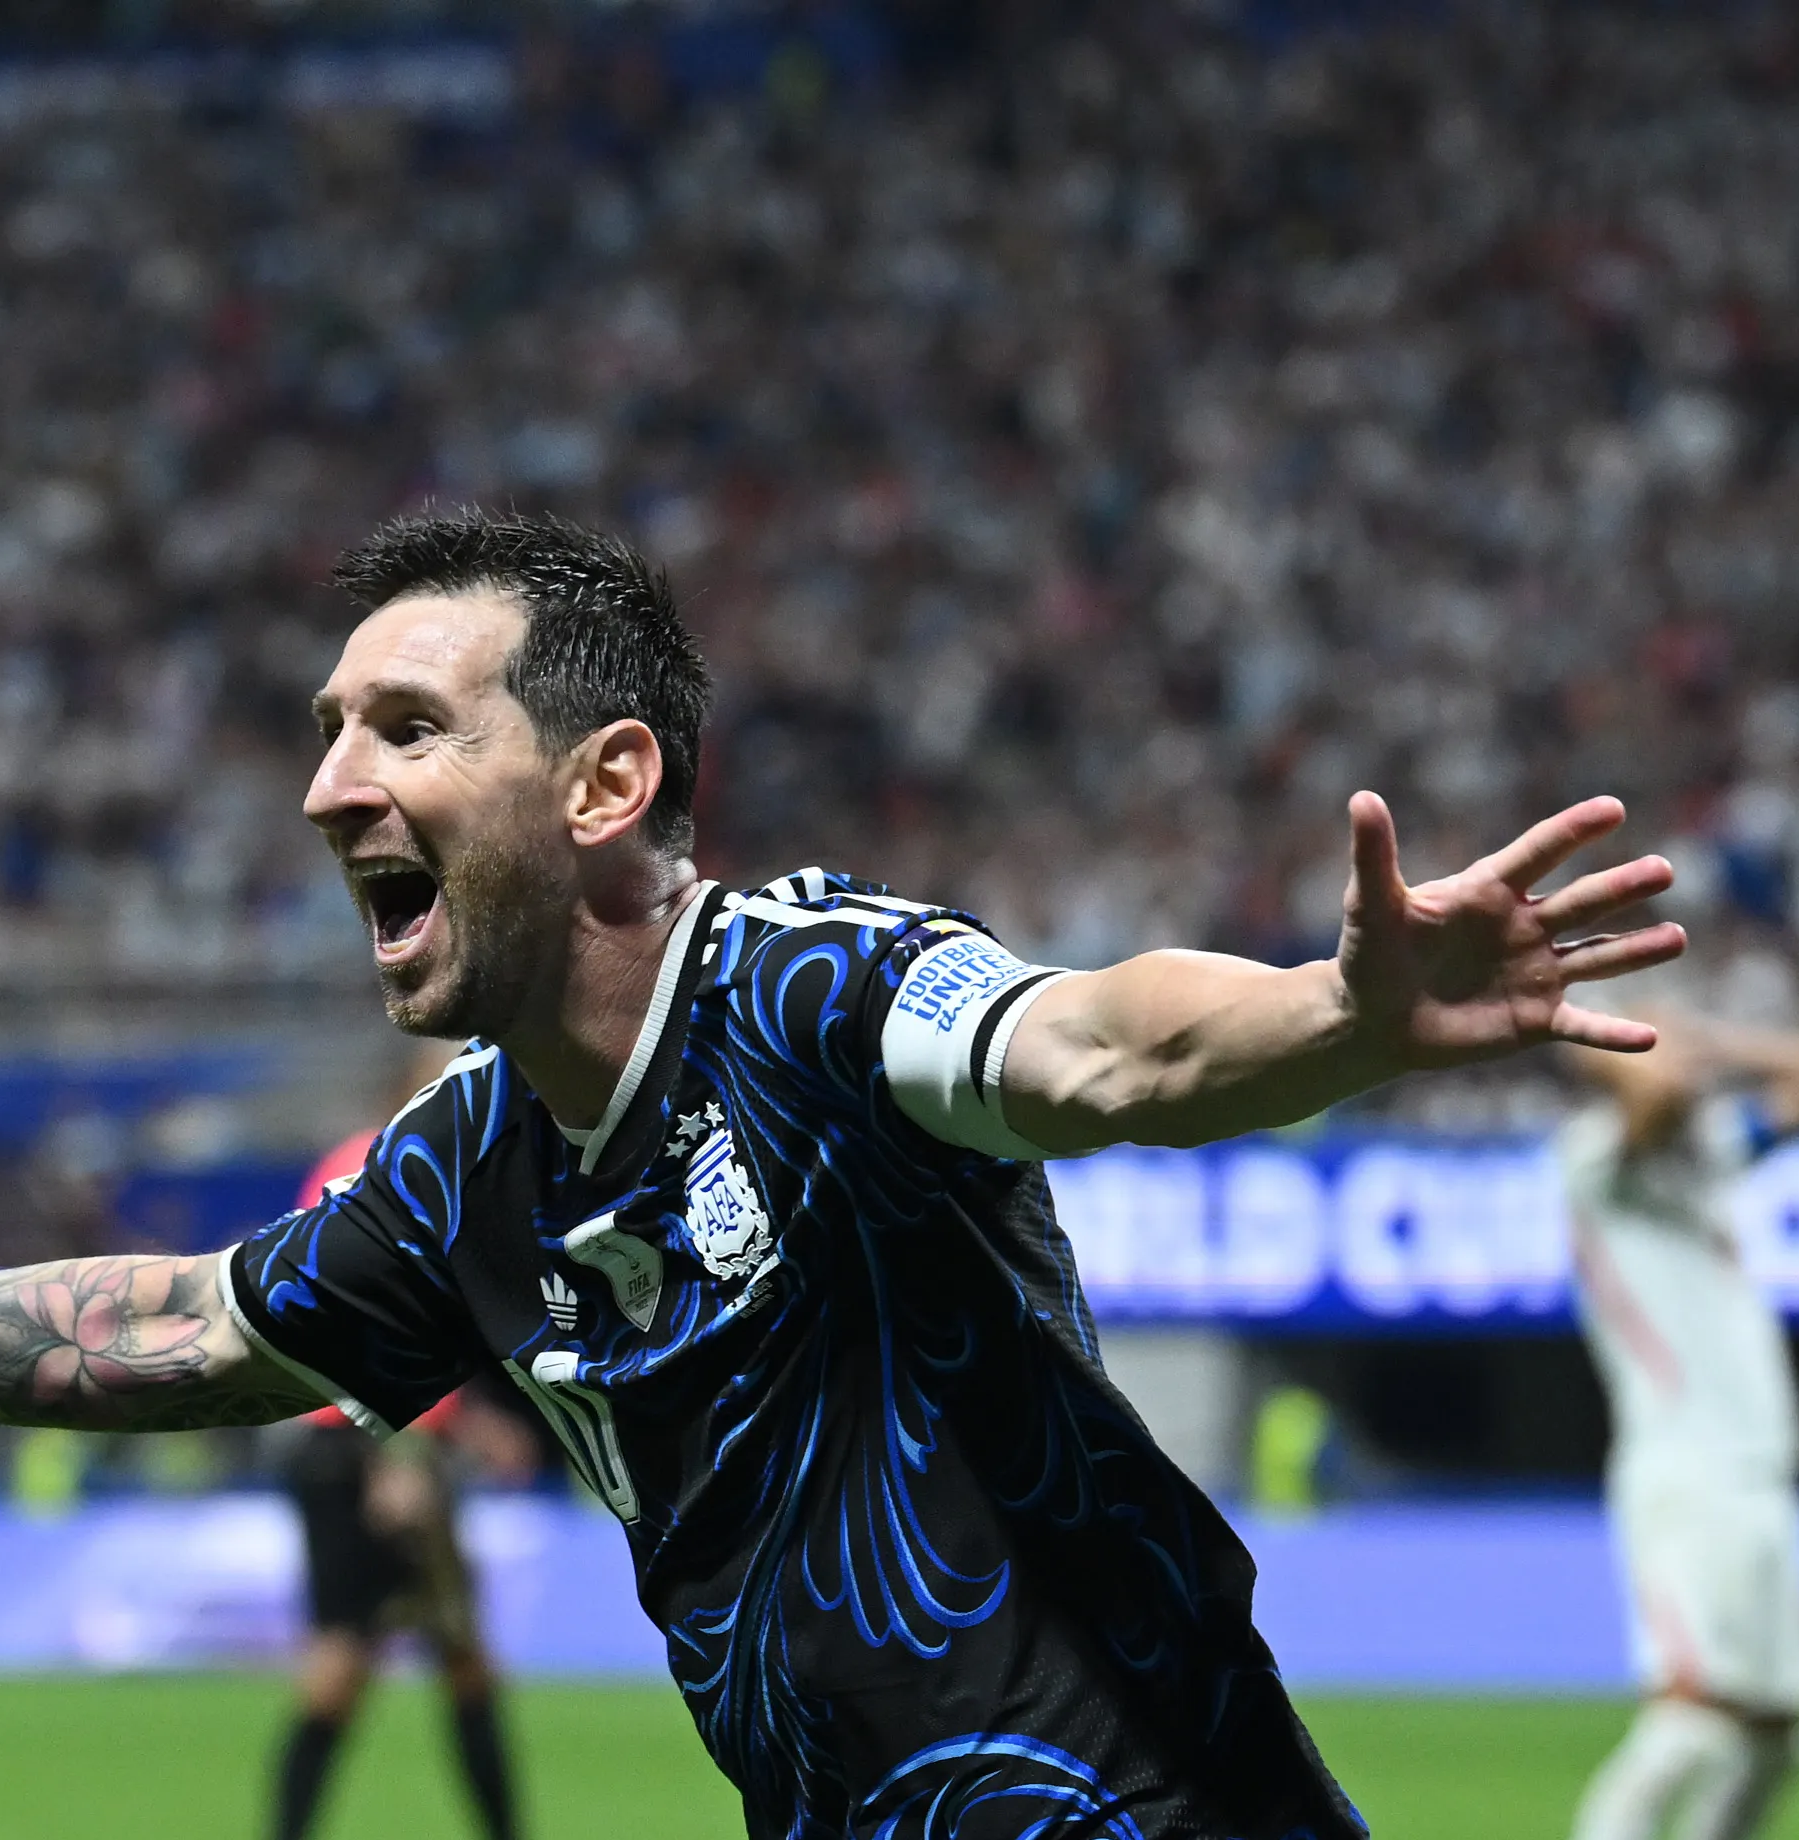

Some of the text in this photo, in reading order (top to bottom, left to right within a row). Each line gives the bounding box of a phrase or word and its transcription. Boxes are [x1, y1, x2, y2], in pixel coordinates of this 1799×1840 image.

[936, 992, 974, 1035] the
[1044, 1145, 1324, 1314] RLD
[628, 1273, 650, 1297] FIFA
